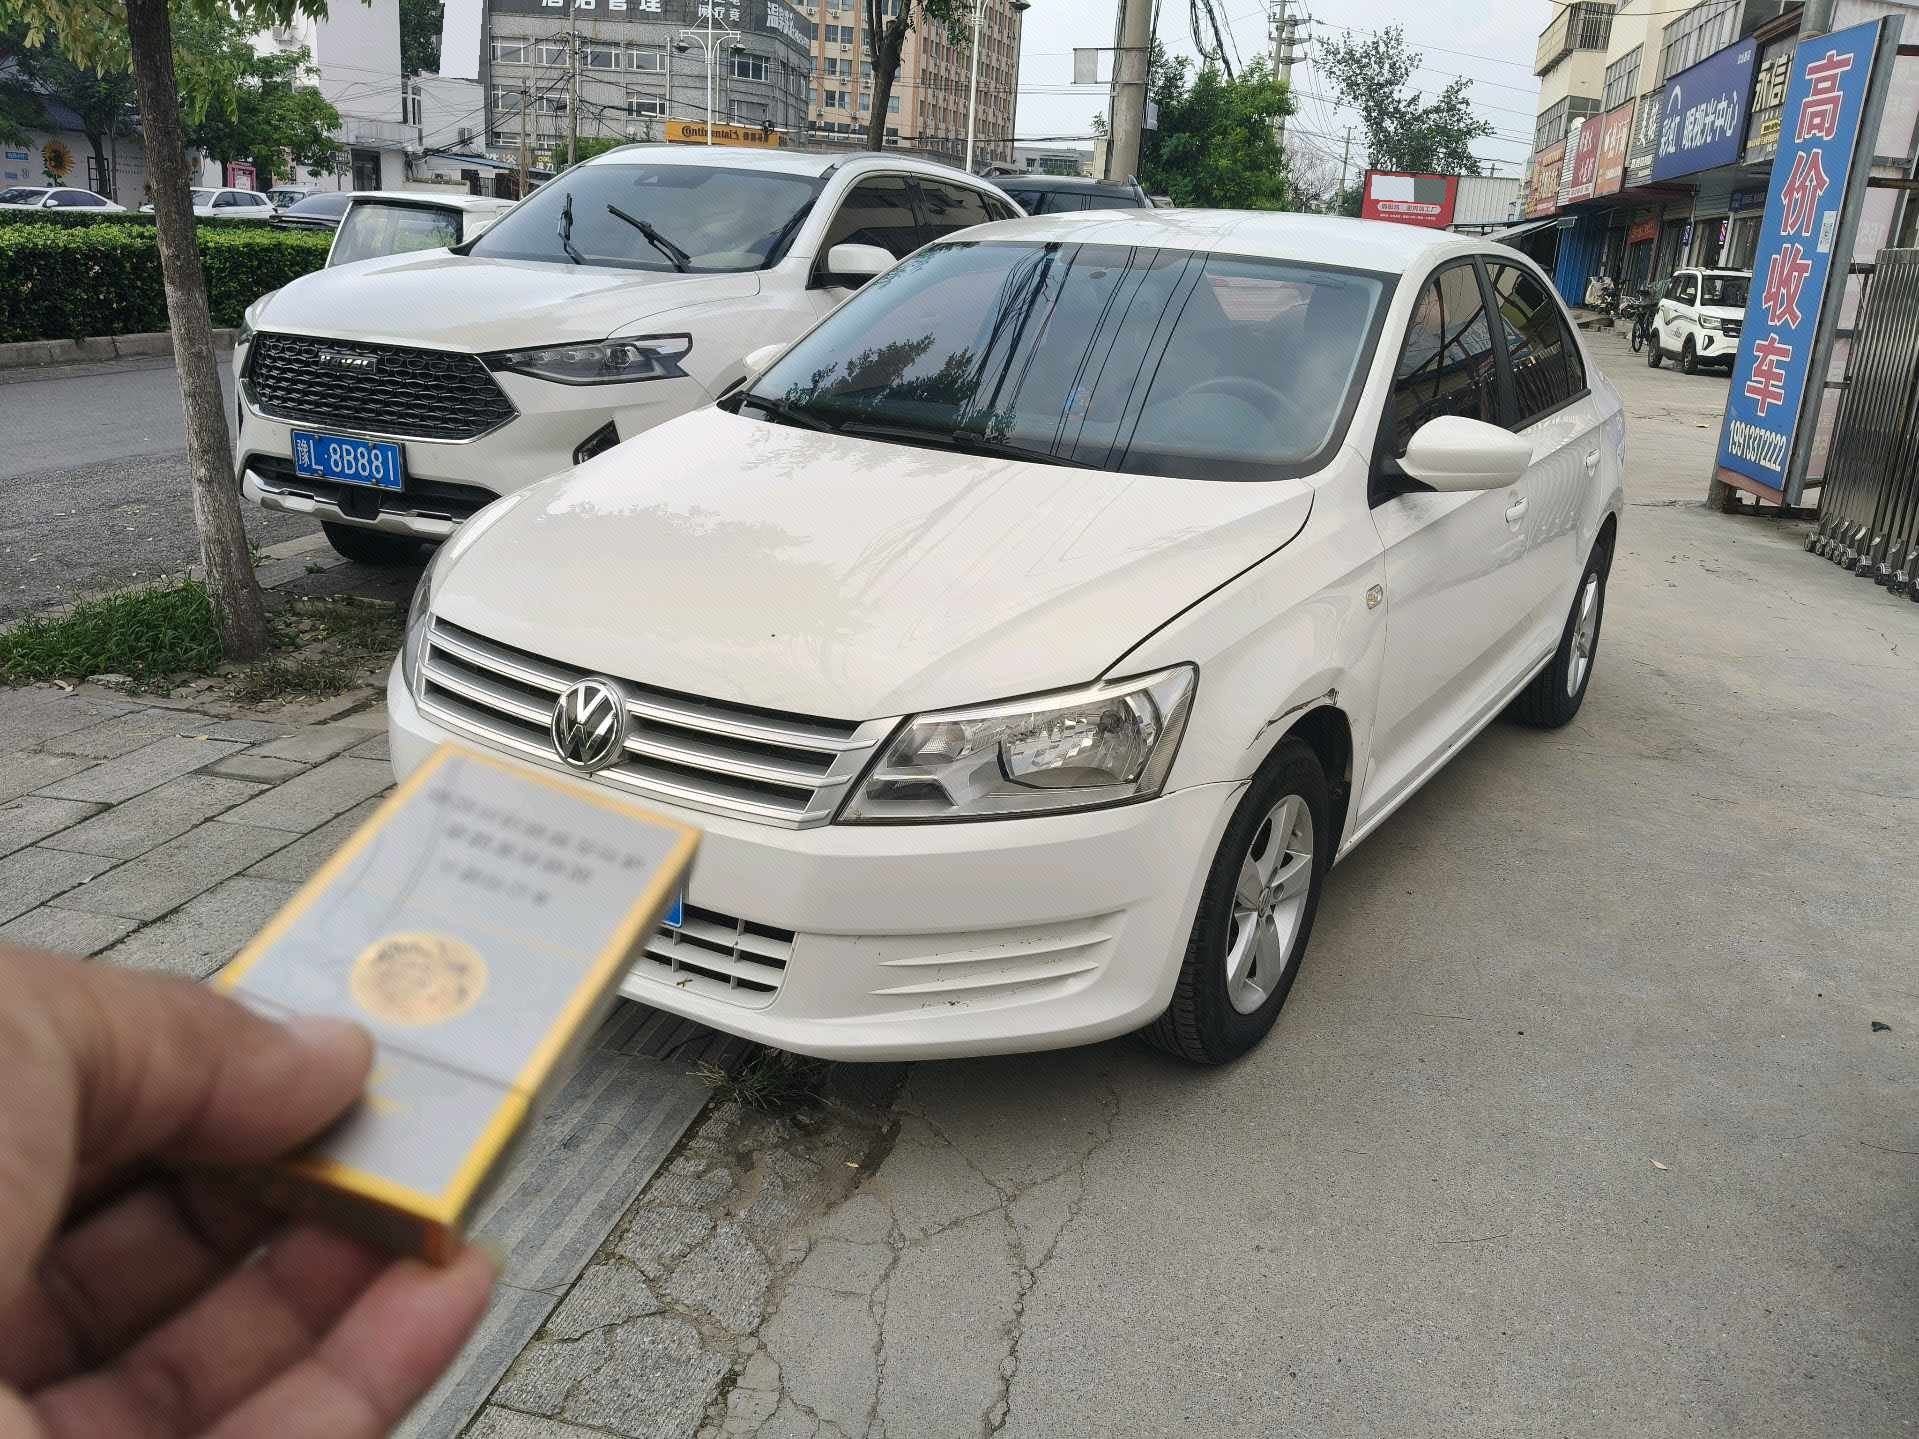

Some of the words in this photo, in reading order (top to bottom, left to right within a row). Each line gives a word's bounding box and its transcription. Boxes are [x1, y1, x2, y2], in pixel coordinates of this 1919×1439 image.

[1744, 50, 1854, 417] 高价收车
[1728, 419, 1787, 473] 19913372222
